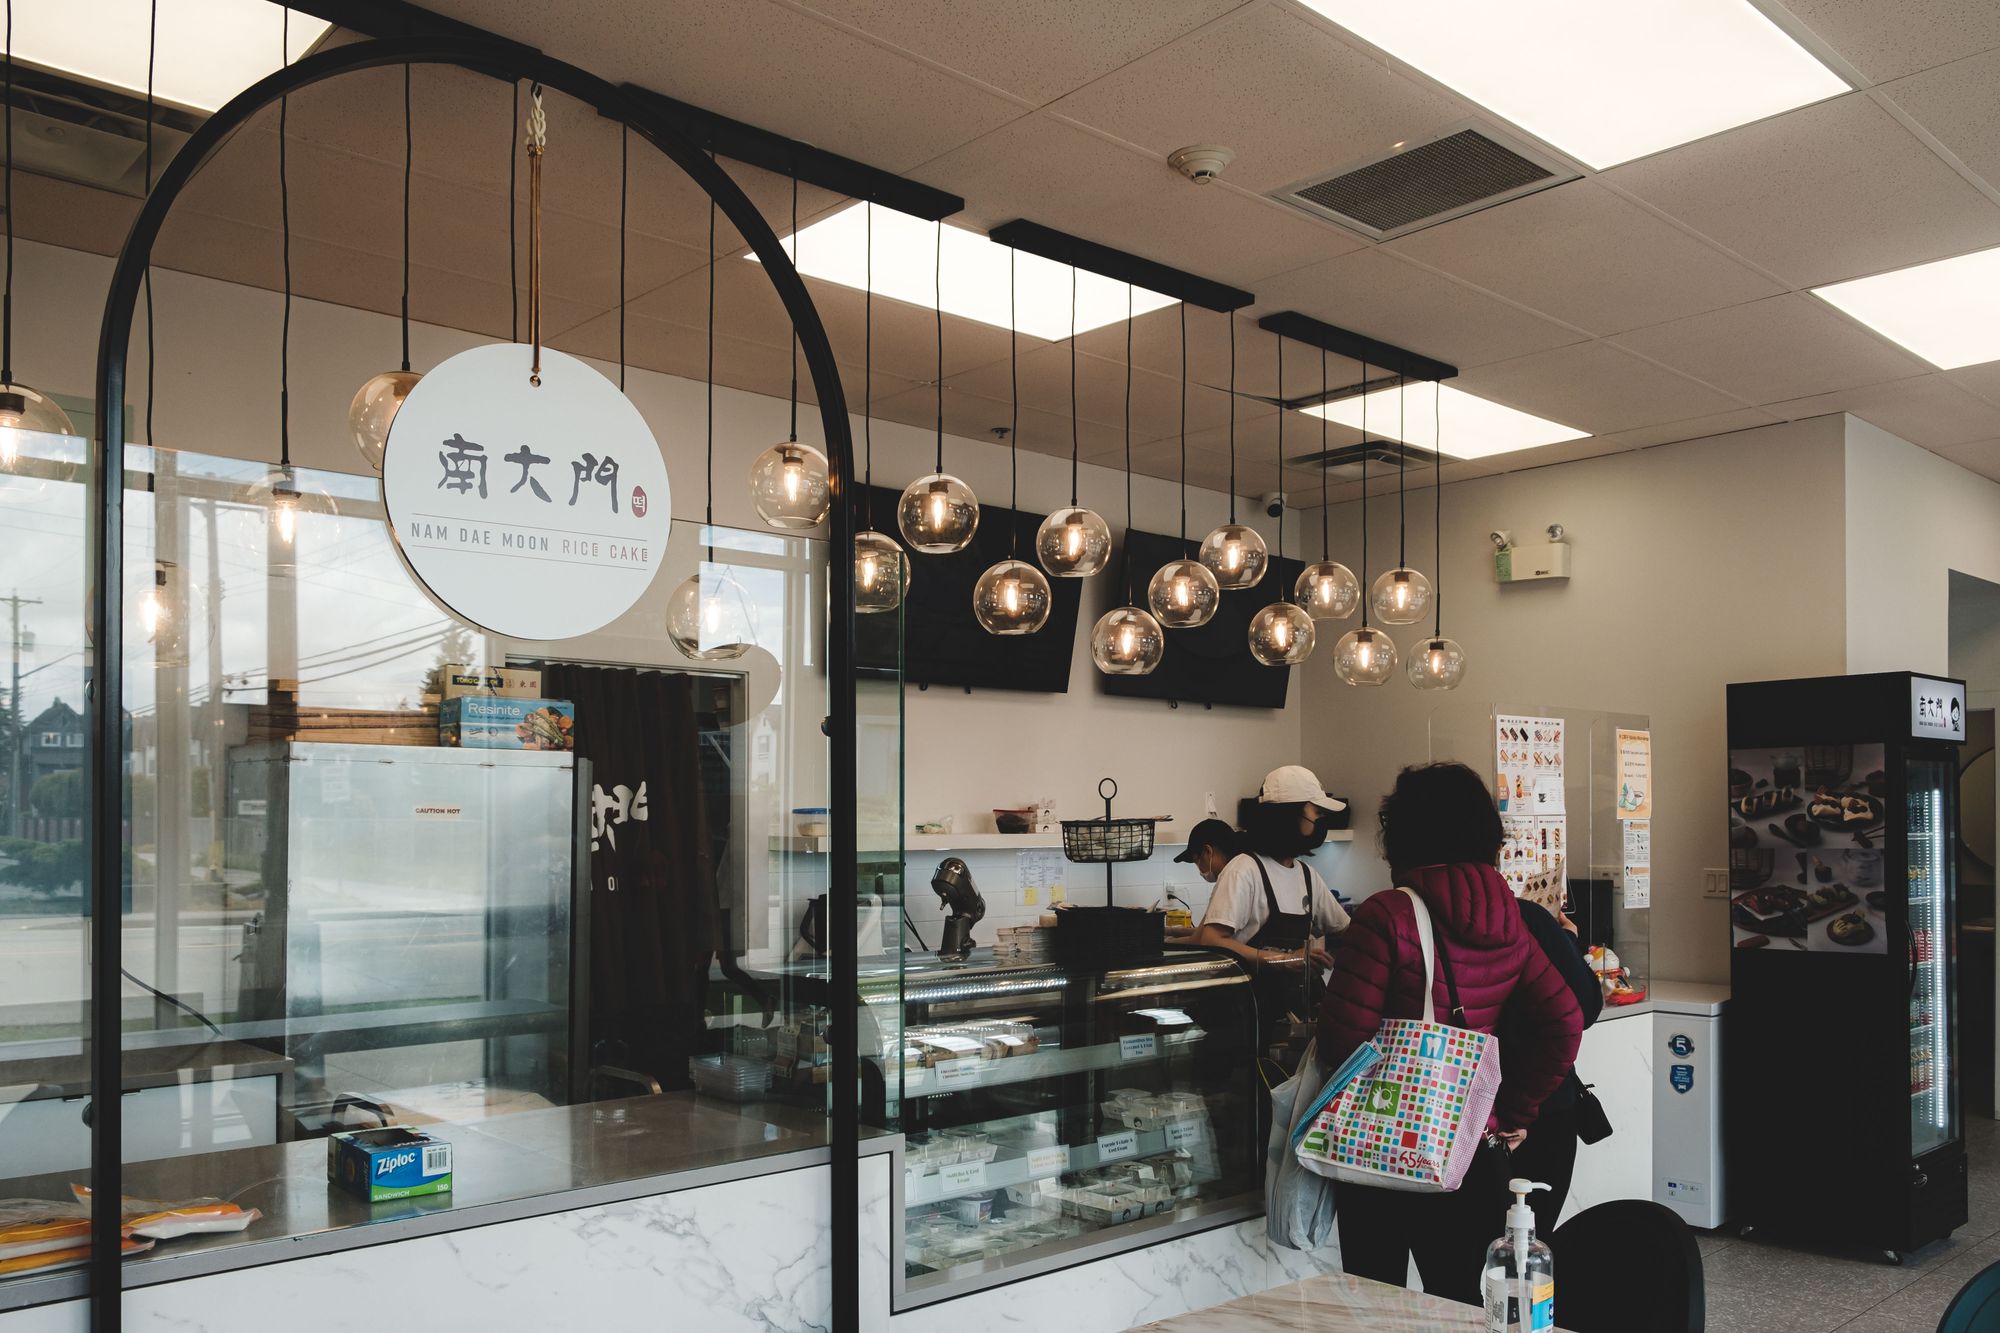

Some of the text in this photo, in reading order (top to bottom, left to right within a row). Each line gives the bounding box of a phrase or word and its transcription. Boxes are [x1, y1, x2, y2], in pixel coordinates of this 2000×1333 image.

[437, 432, 619, 514] 南大門
[411, 522, 648, 563] NAM DAE MOON RICE CAKE
[468, 702, 521, 716] Resinite
[377, 1152, 416, 1176] Ziploc
[1399, 1150, 1416, 1169] 65
[374, 1190, 410, 1200] SANDWICH
